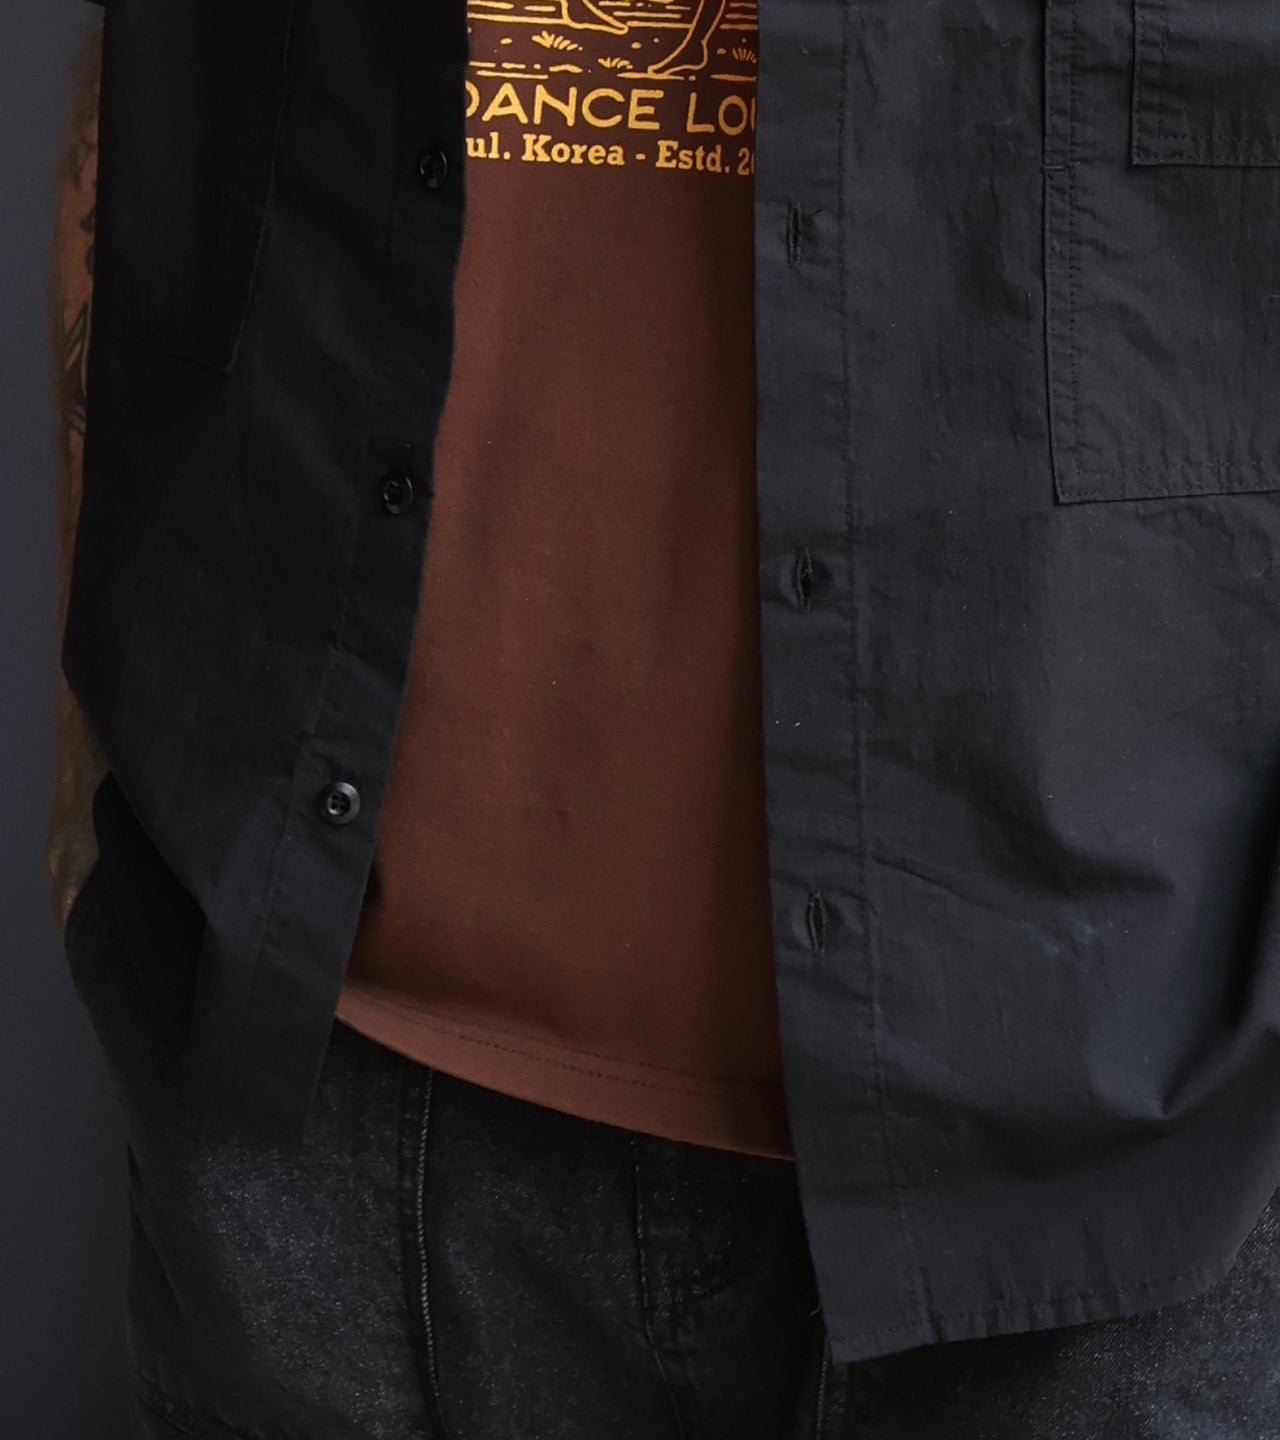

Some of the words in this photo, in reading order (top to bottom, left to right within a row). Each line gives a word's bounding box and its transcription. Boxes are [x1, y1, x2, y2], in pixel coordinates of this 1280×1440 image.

[686, 91, 756, 137] LO
[521, 132, 625, 166] Korea
[655, 139, 730, 175] Estd.
